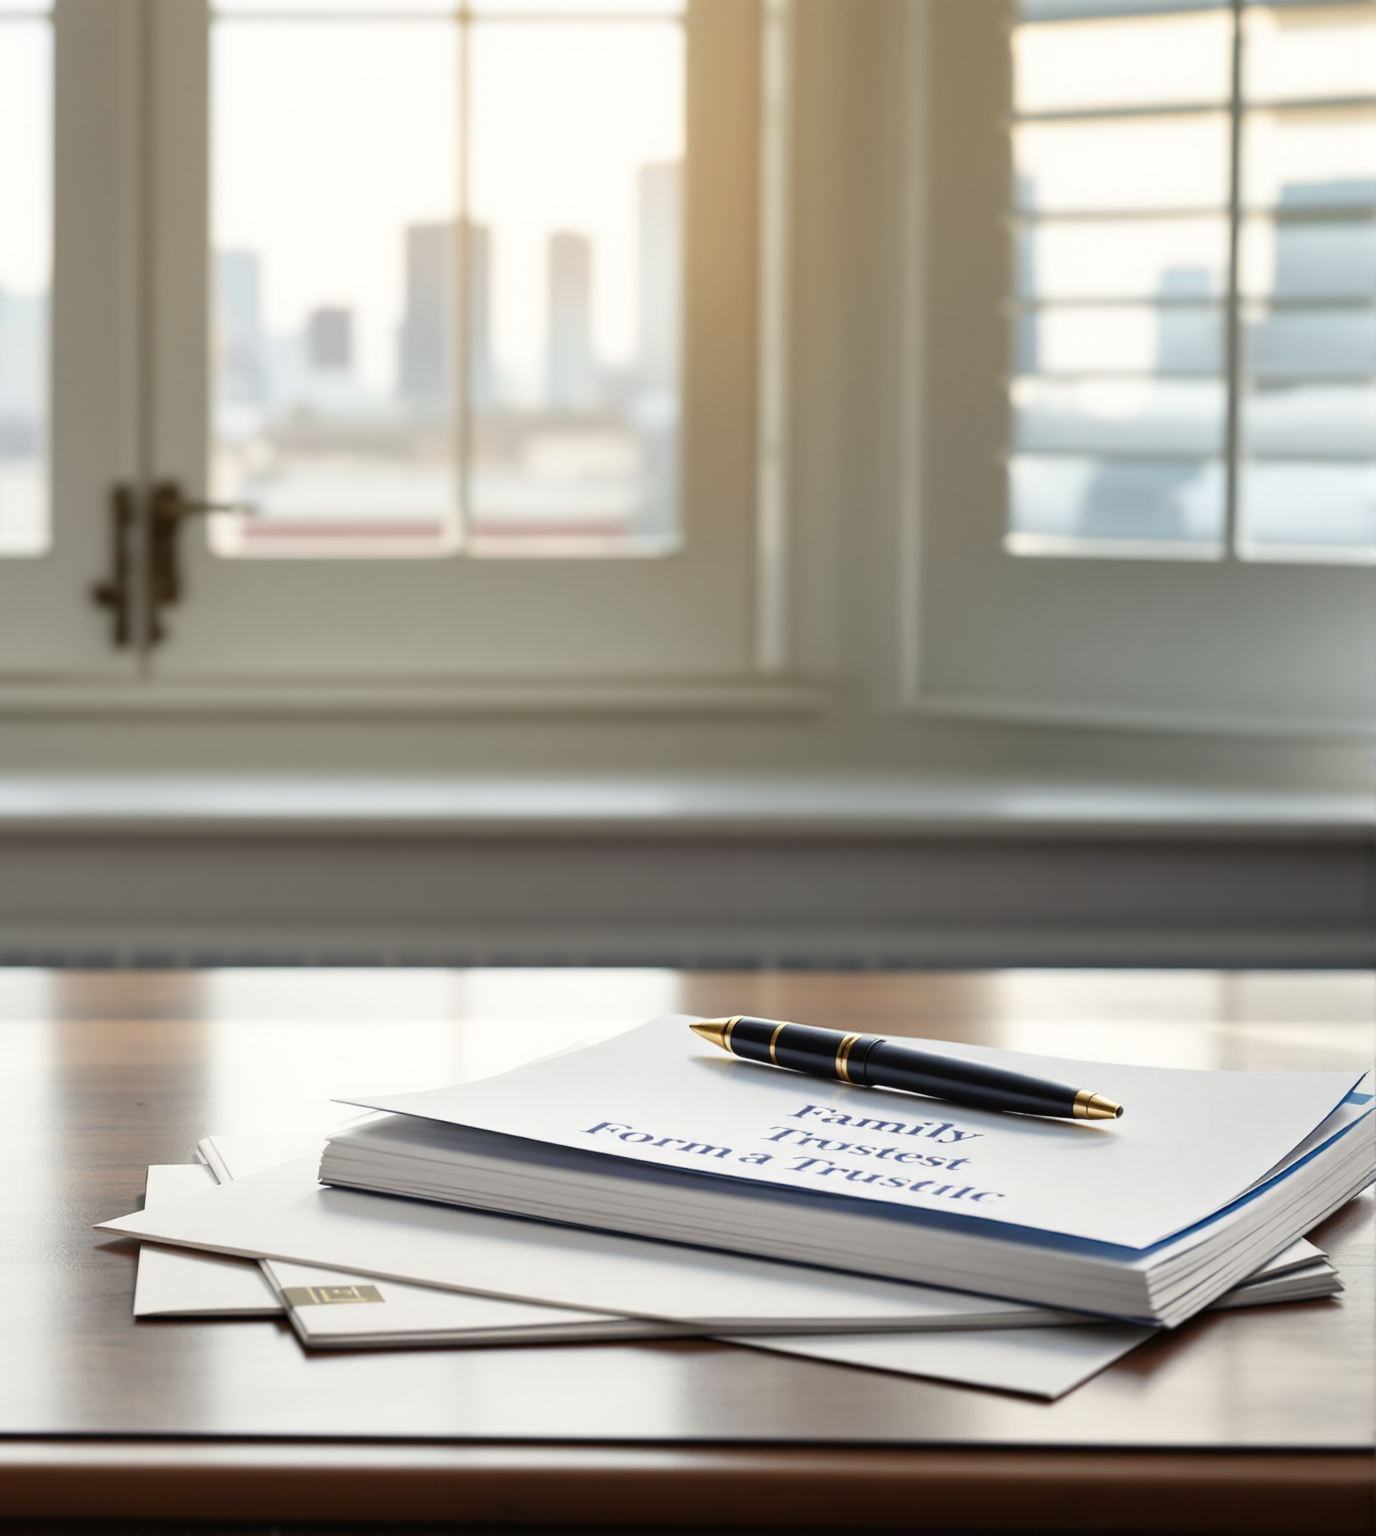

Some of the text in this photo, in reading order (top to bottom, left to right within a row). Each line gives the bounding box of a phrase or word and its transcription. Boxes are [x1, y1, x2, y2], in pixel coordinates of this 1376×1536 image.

[580, 1121, 733, 1159] Form
[738, 1152, 775, 1165] a
[787, 1104, 985, 1144] Family
